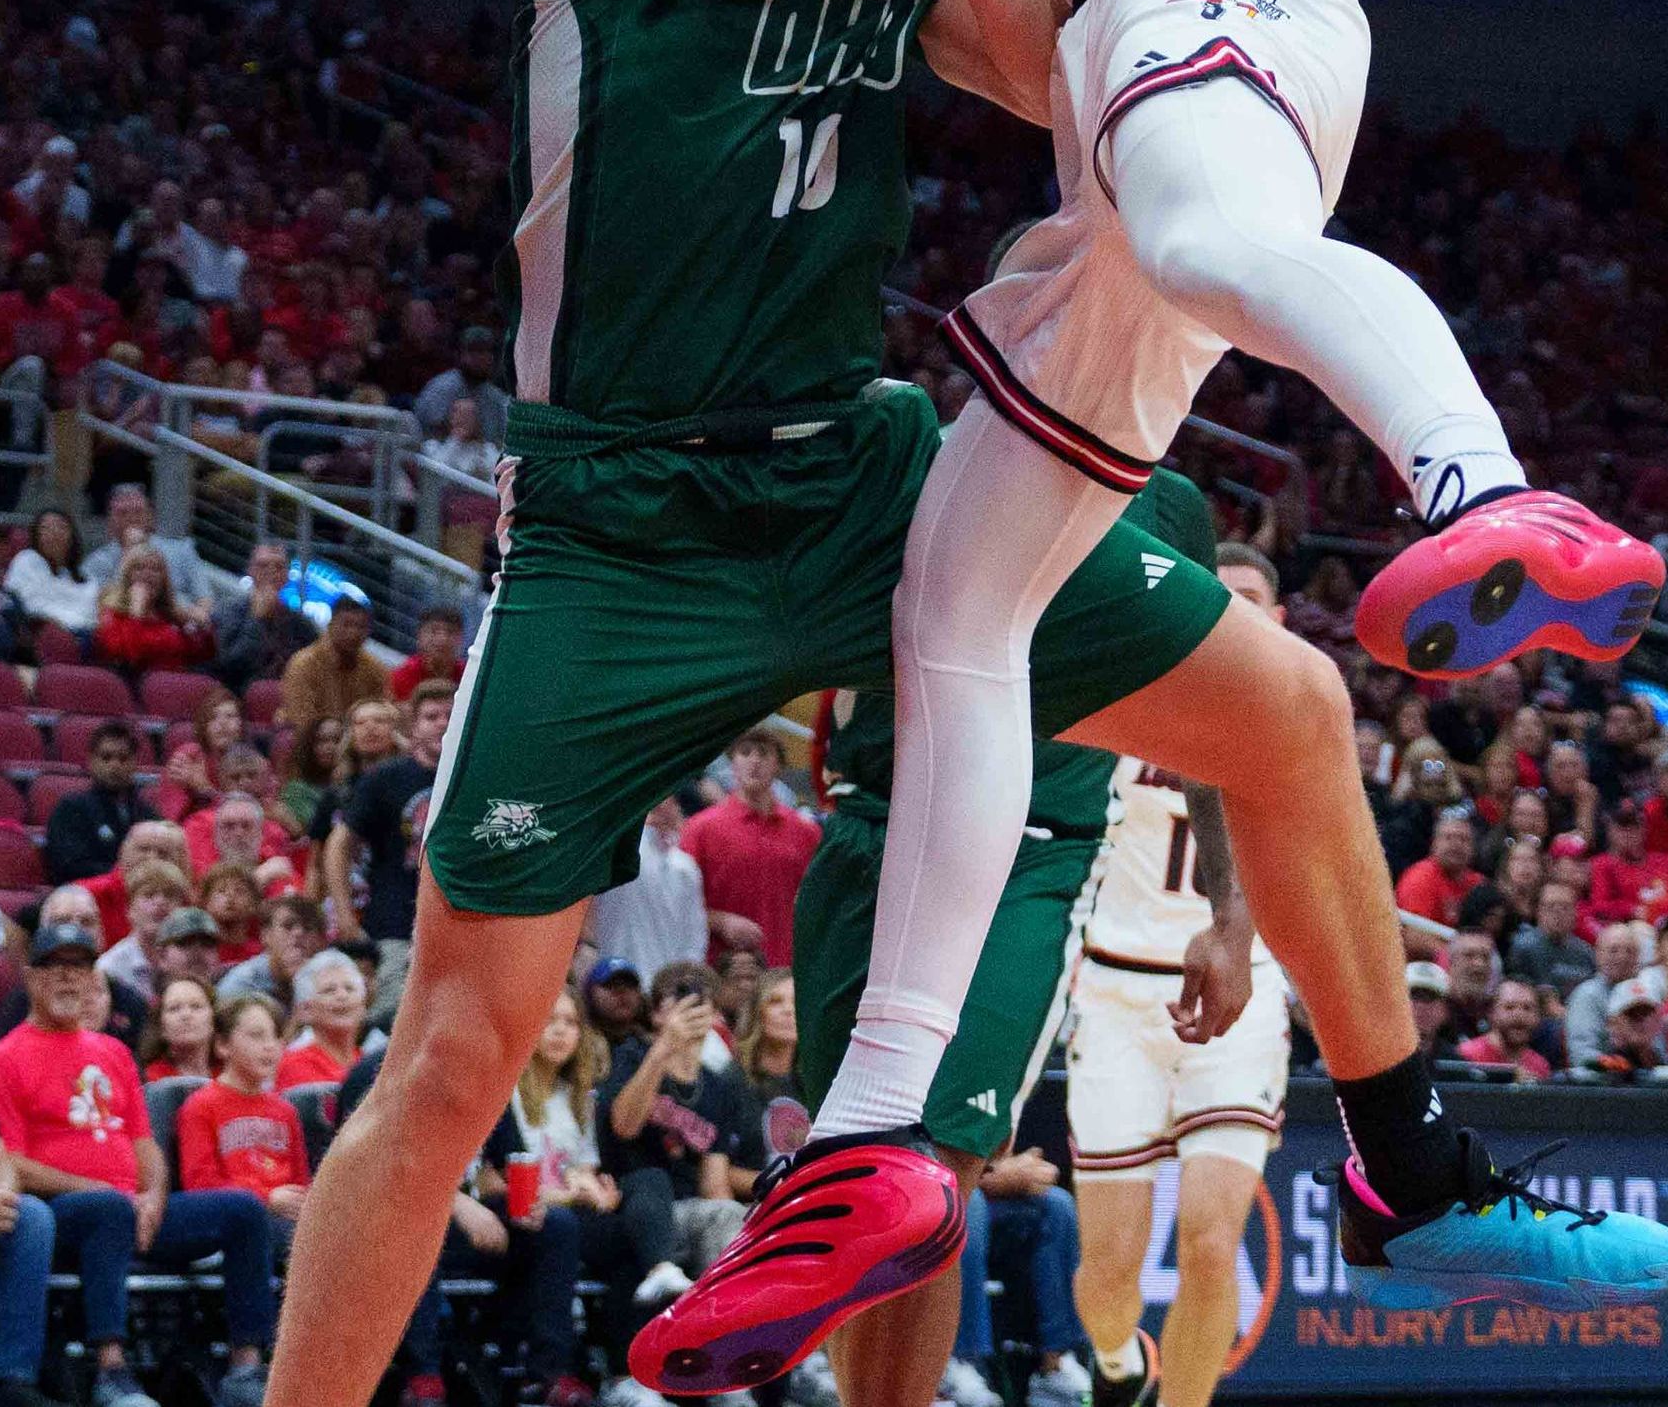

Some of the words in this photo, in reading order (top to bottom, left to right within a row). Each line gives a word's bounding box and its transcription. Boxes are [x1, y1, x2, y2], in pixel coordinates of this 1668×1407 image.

[771, 113, 843, 219] 10
[1297, 1308, 1451, 1347] INJURY
[1463, 1305, 1663, 1349] LAWYERS
